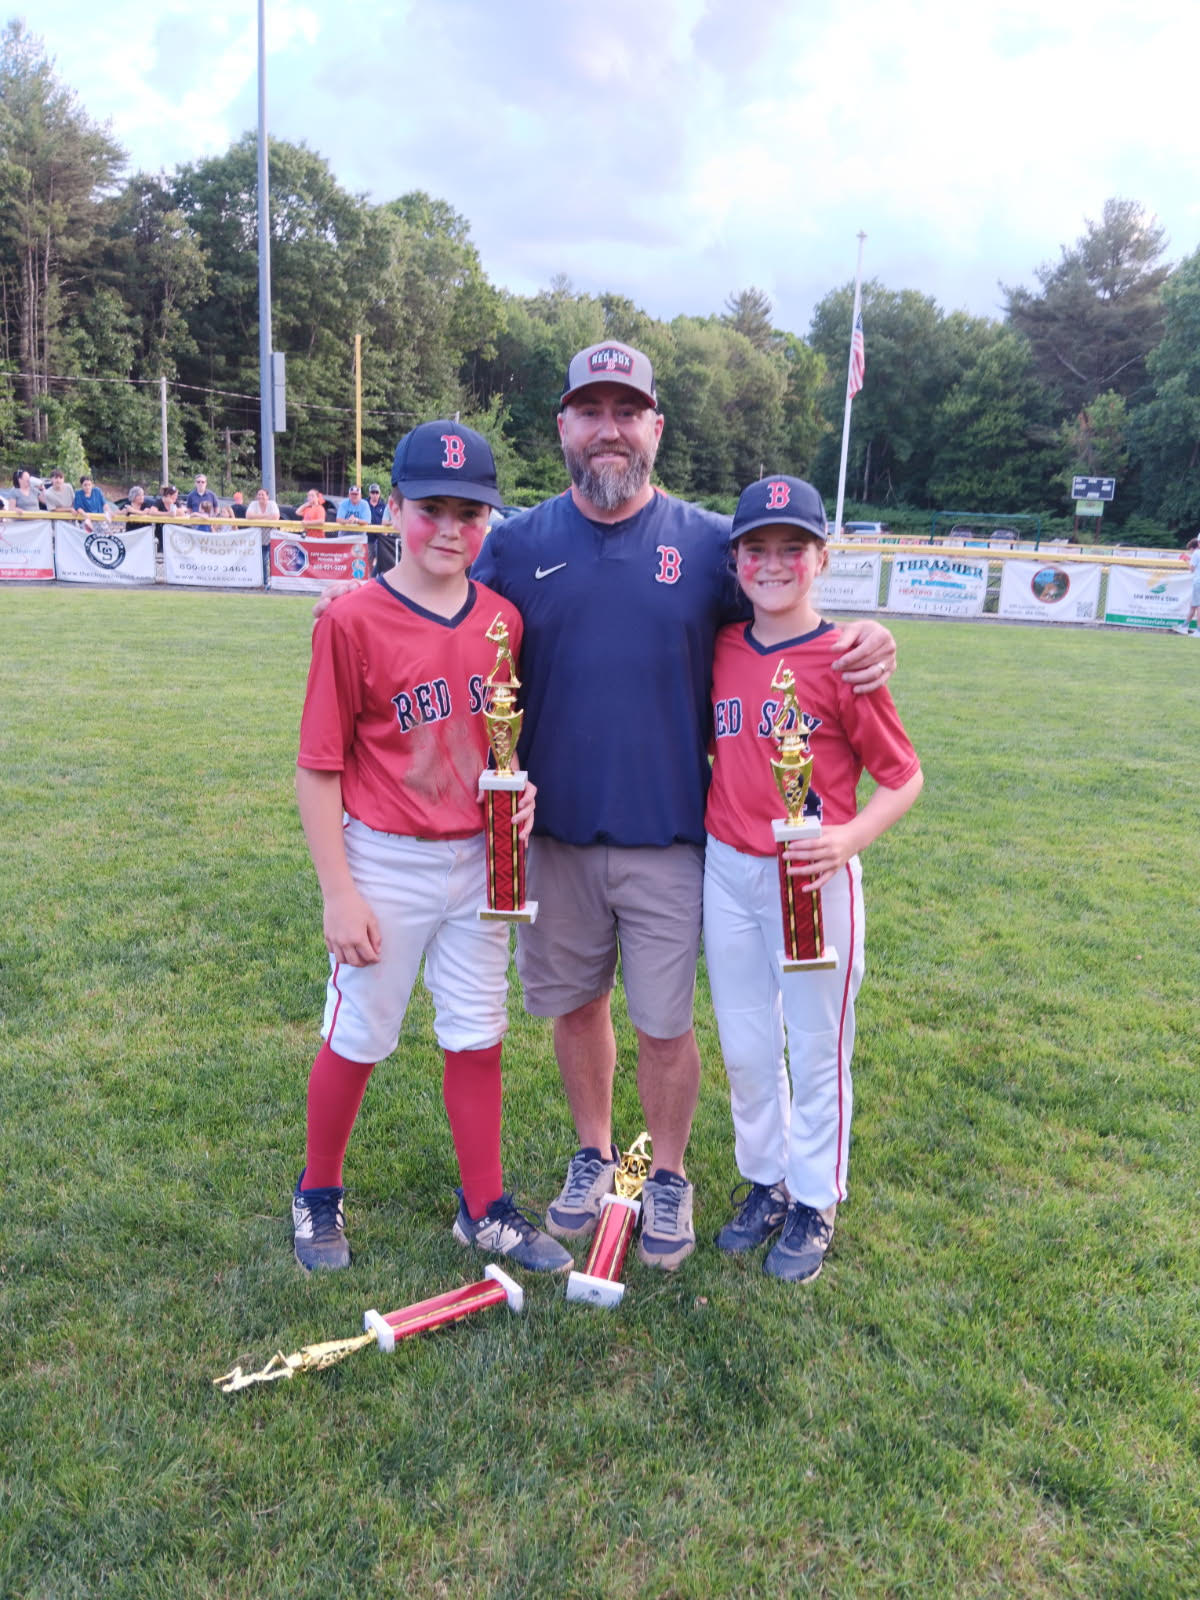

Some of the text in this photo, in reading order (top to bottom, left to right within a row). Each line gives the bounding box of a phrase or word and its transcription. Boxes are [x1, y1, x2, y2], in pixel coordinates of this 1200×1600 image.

[591, 349, 630, 367] RED SOX
[440, 434, 466, 469] B
[766, 481, 791, 510] B
[655, 545, 682, 584] B
[896, 560, 984, 580] THRASHER
[391, 677, 452, 733] RED
[715, 697, 743, 740] ED
